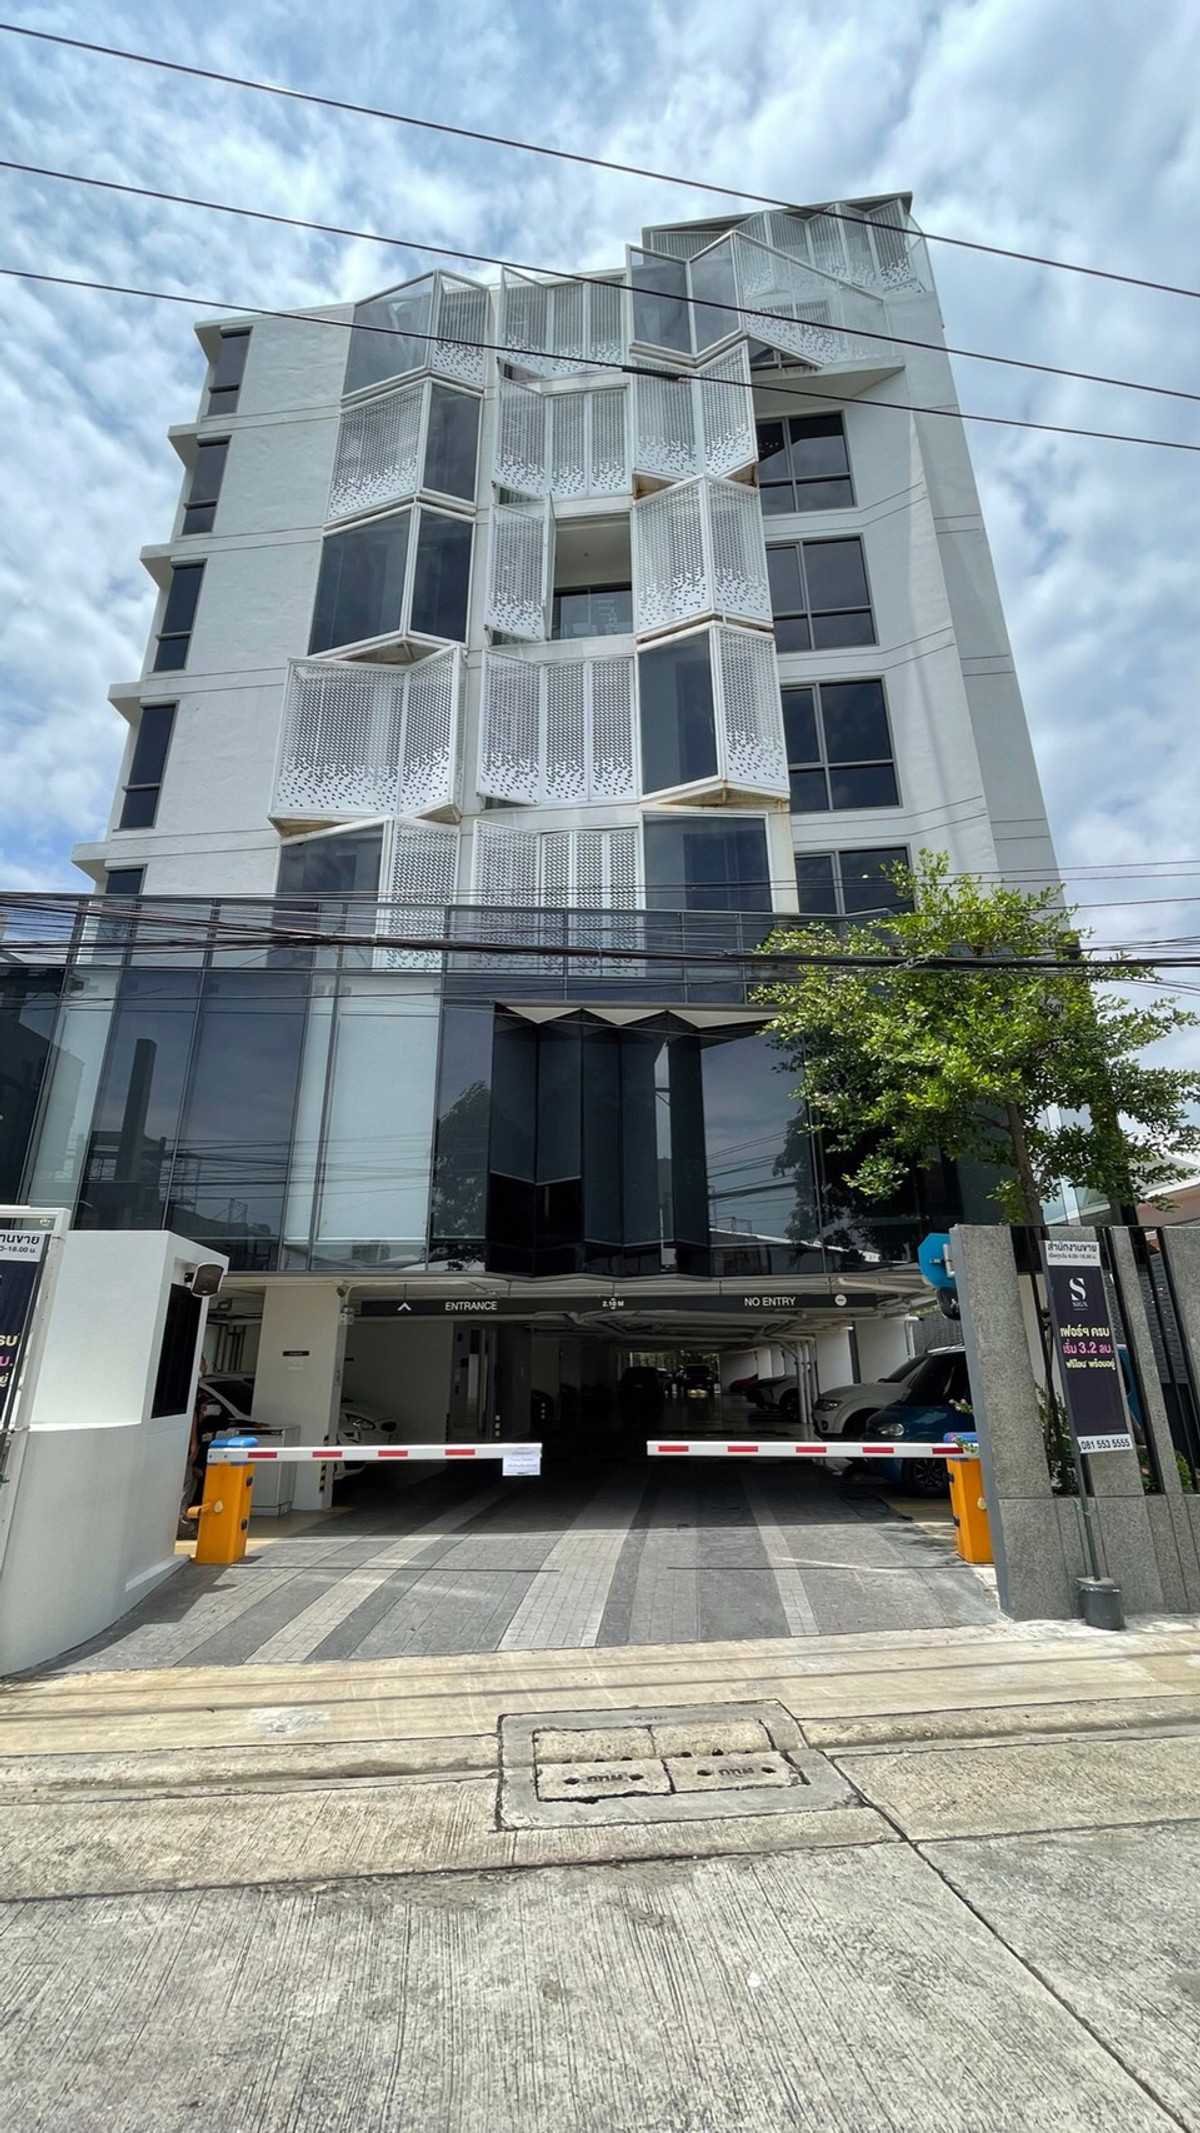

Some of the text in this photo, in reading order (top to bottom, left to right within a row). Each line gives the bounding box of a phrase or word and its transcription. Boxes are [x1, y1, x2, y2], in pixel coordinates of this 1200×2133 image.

[1047, 1240, 1097, 1252] สำนักงานขาย
[1069, 1277, 1086, 1301] S
[445, 1301, 498, 1311] ENTRANCE
[744, 1296, 796, 1306] NO ENTRY
[1078, 1341, 1097, 1354] 3.2
[1081, 1438, 1130, 1450] 081 553 5555
